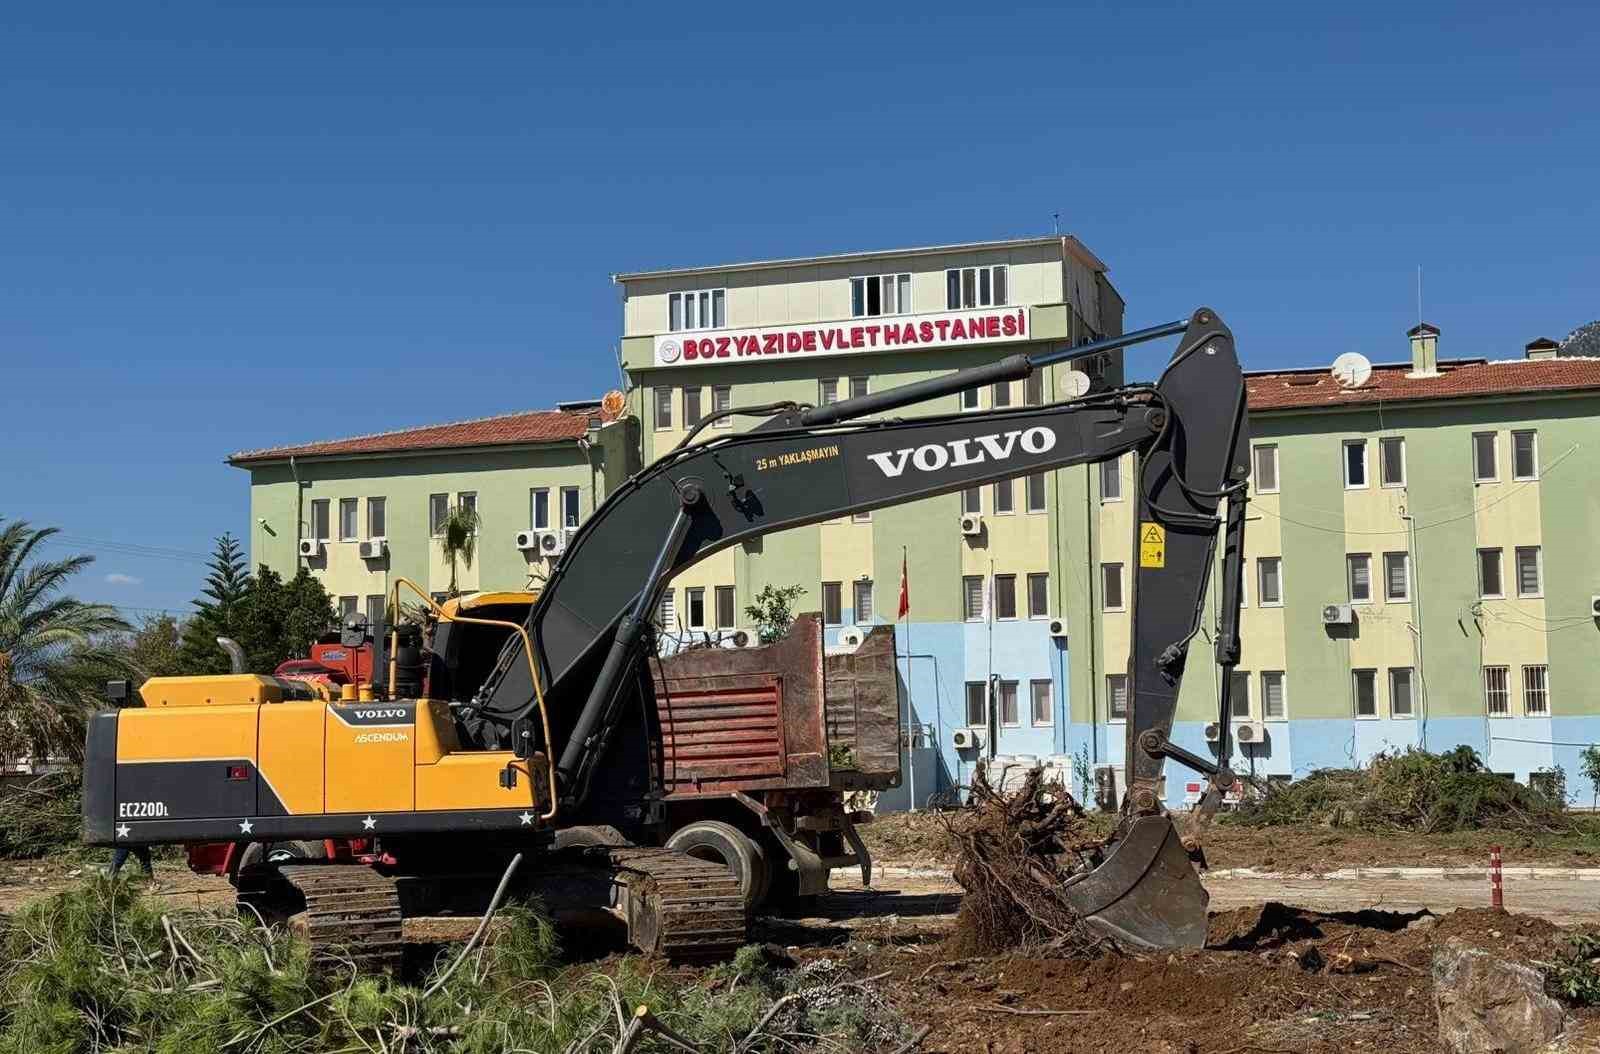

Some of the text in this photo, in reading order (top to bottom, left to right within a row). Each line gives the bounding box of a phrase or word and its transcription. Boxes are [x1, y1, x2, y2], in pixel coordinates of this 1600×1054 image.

[756, 445, 839, 470] 25 m YAKLAŞMAYIN
[867, 426, 1057, 477] VOLVO
[354, 709, 406, 719] VOLVO
